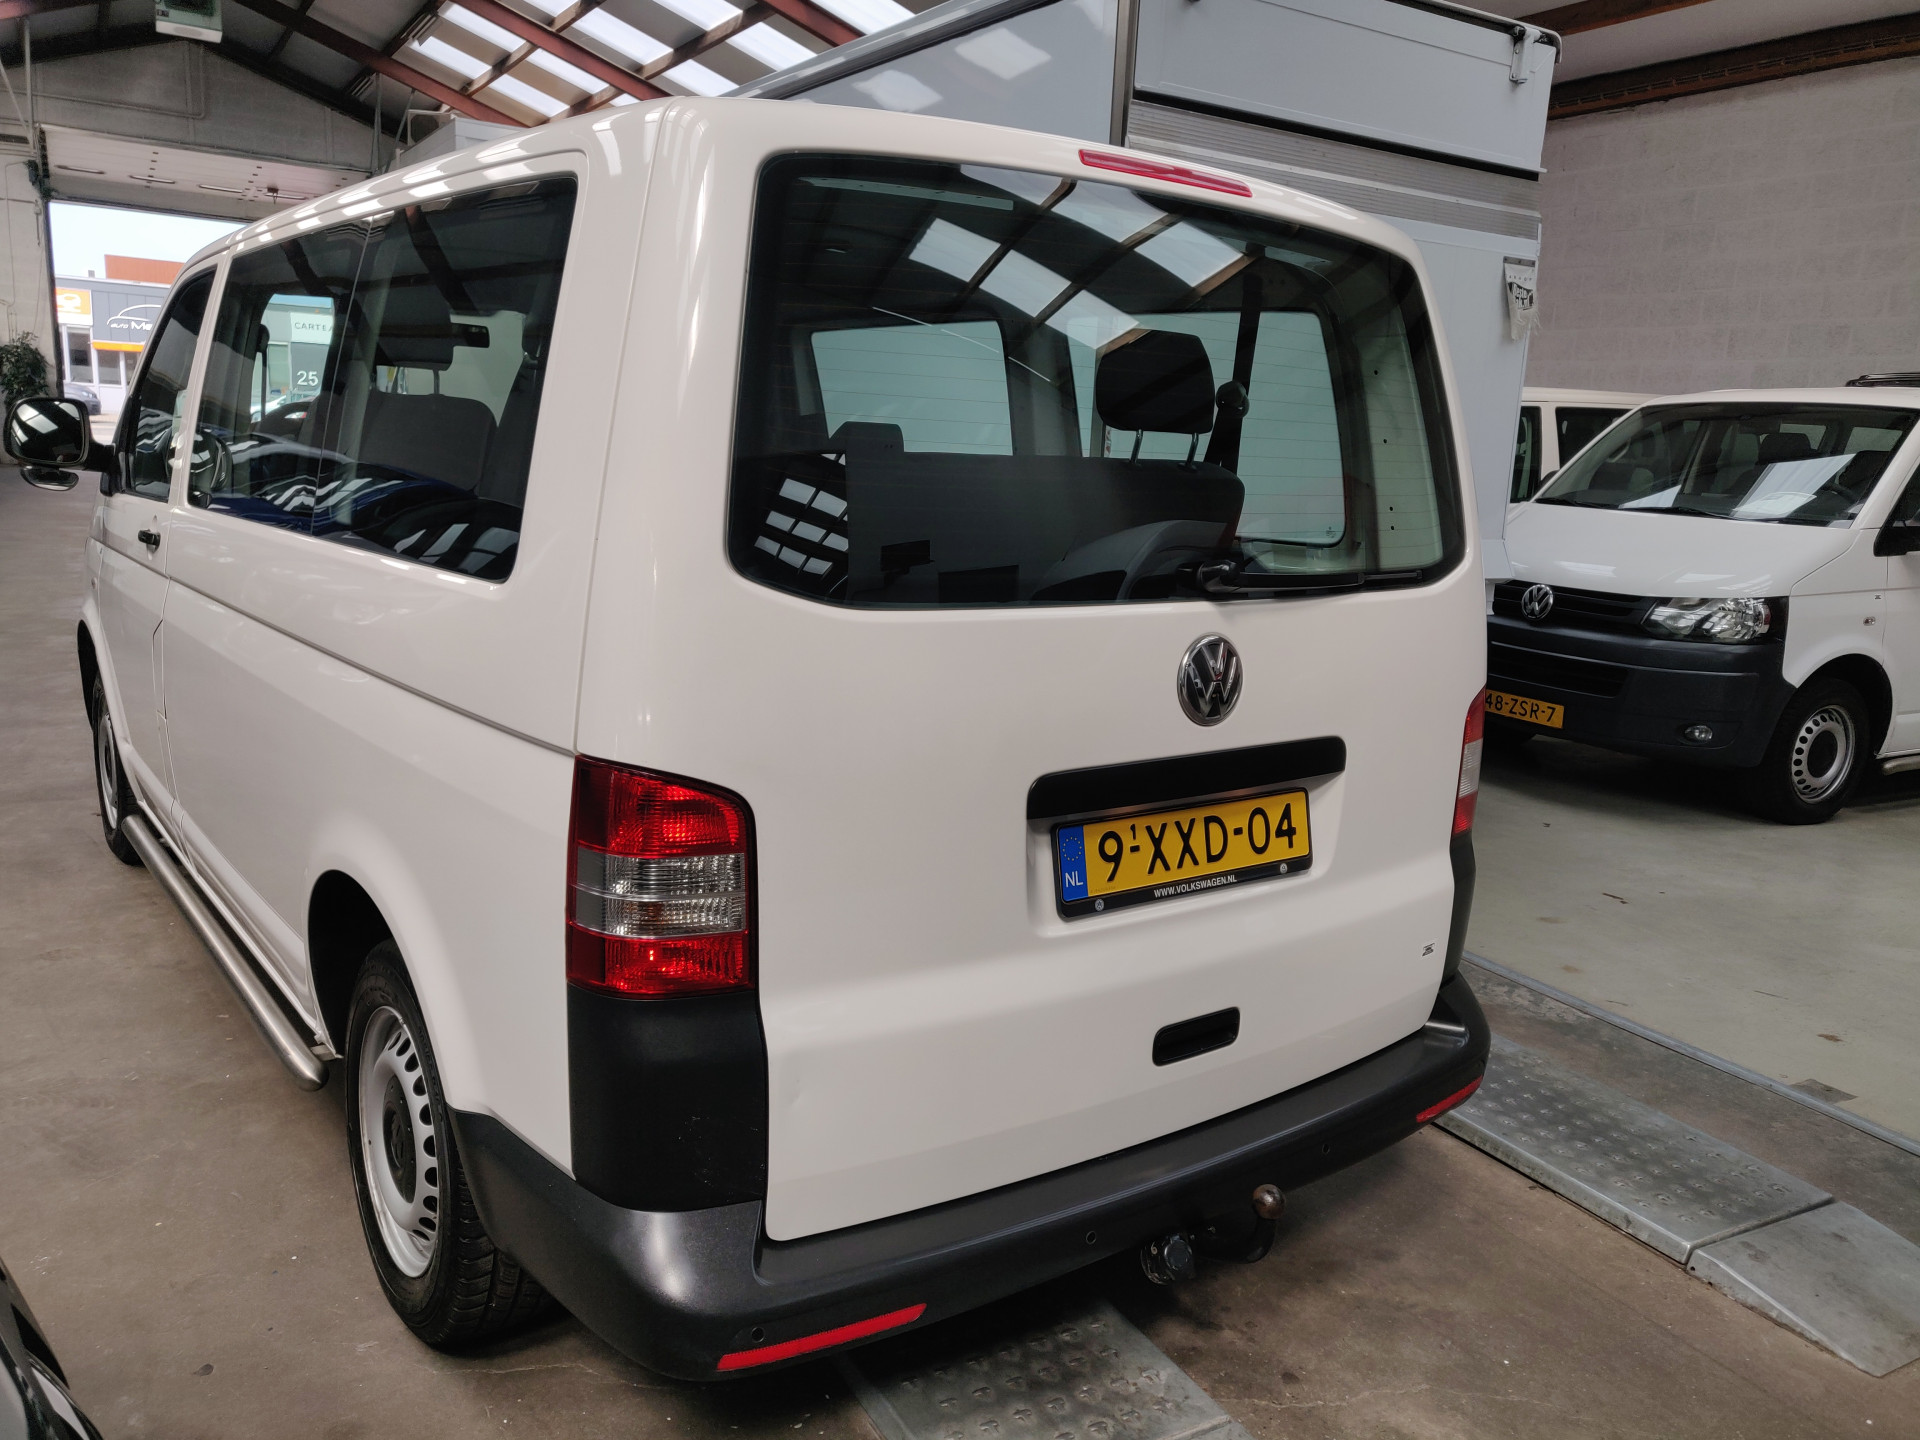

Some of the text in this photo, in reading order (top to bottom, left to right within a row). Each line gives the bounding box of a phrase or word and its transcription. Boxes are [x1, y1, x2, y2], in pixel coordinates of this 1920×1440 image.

[296, 370, 319, 387] 25
[1485, 692, 1557, 723] 48-ZSR-7
[1065, 870, 1084, 888] NL
[1153, 873, 1238, 898] WWW.VOLKSWAGEN.NL
